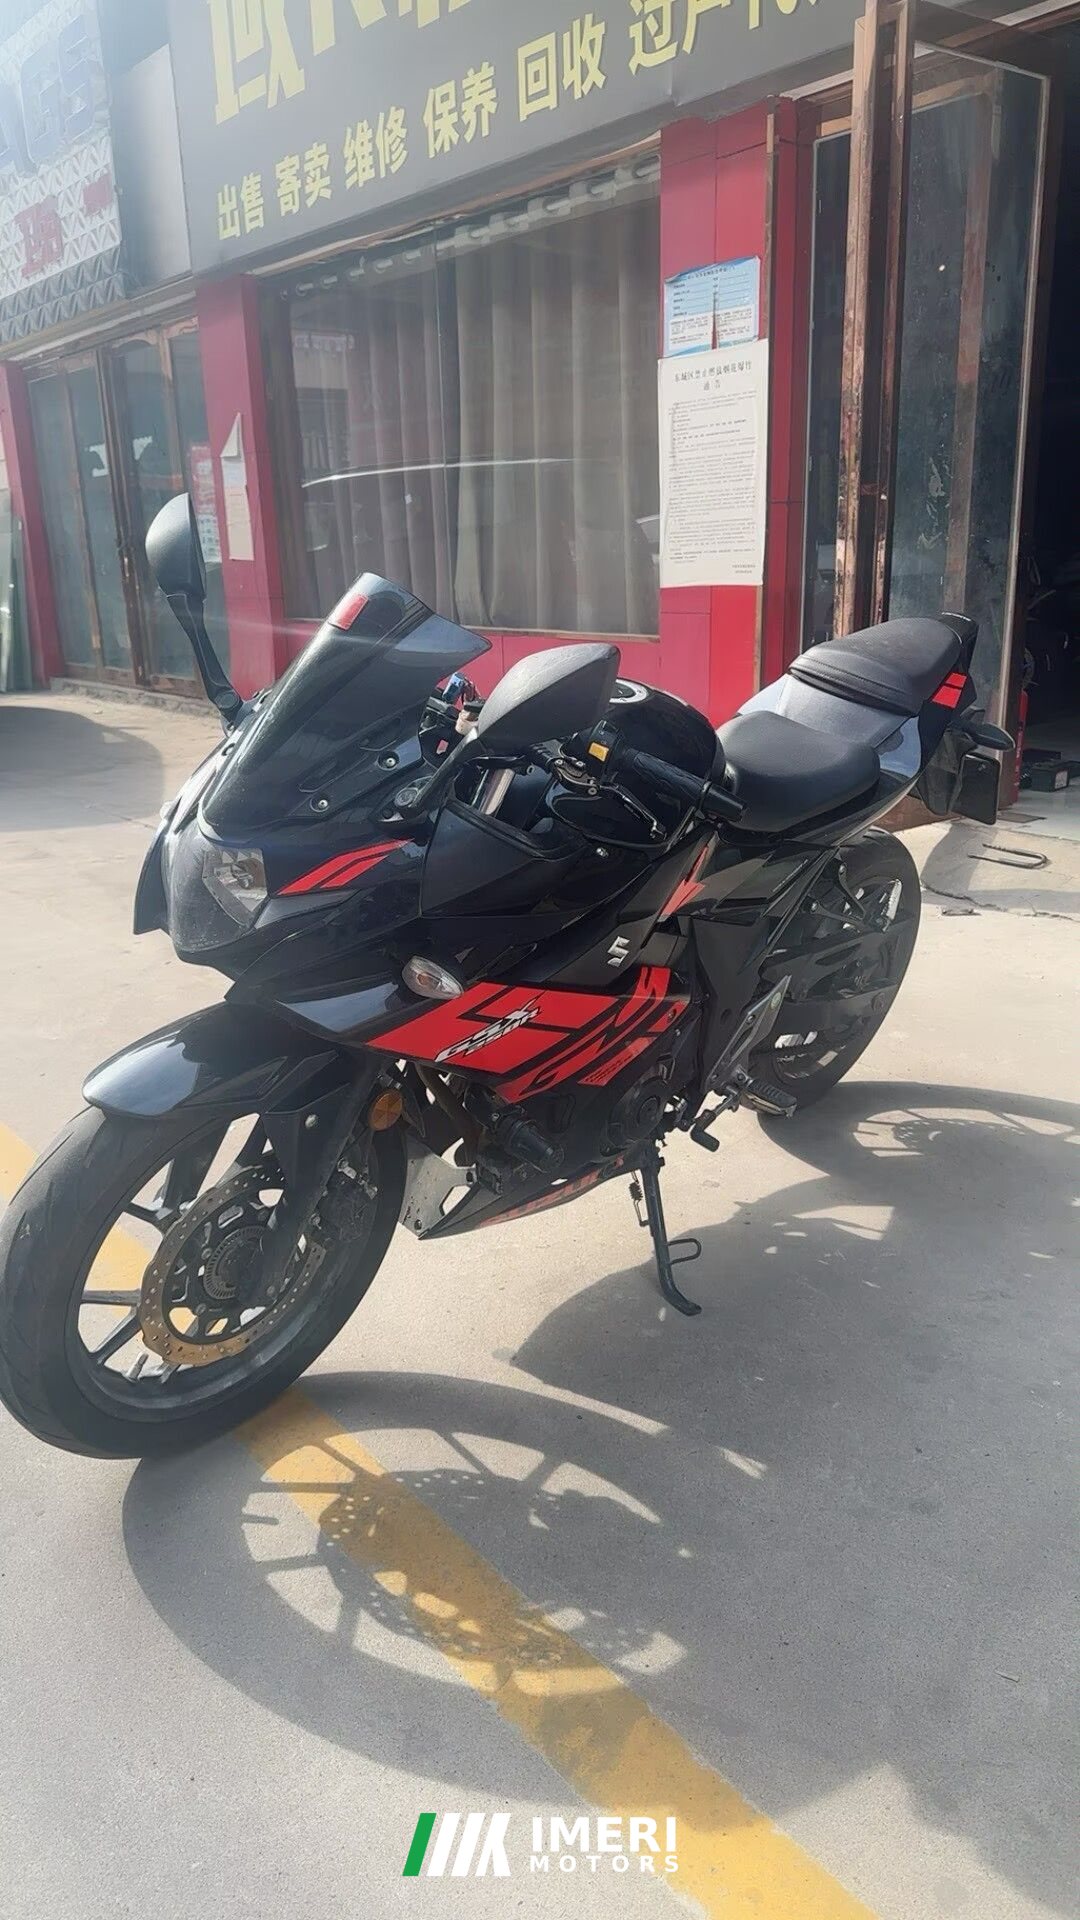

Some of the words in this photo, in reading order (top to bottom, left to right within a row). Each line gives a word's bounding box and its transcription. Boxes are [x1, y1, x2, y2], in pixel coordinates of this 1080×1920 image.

[217, 173, 265, 241] 出售
[275, 142, 332, 217] 寄卖
[343, 106, 408, 190] 维修
[423, 61, 498, 158] 保养
[517, 14, 606, 121] 回收
